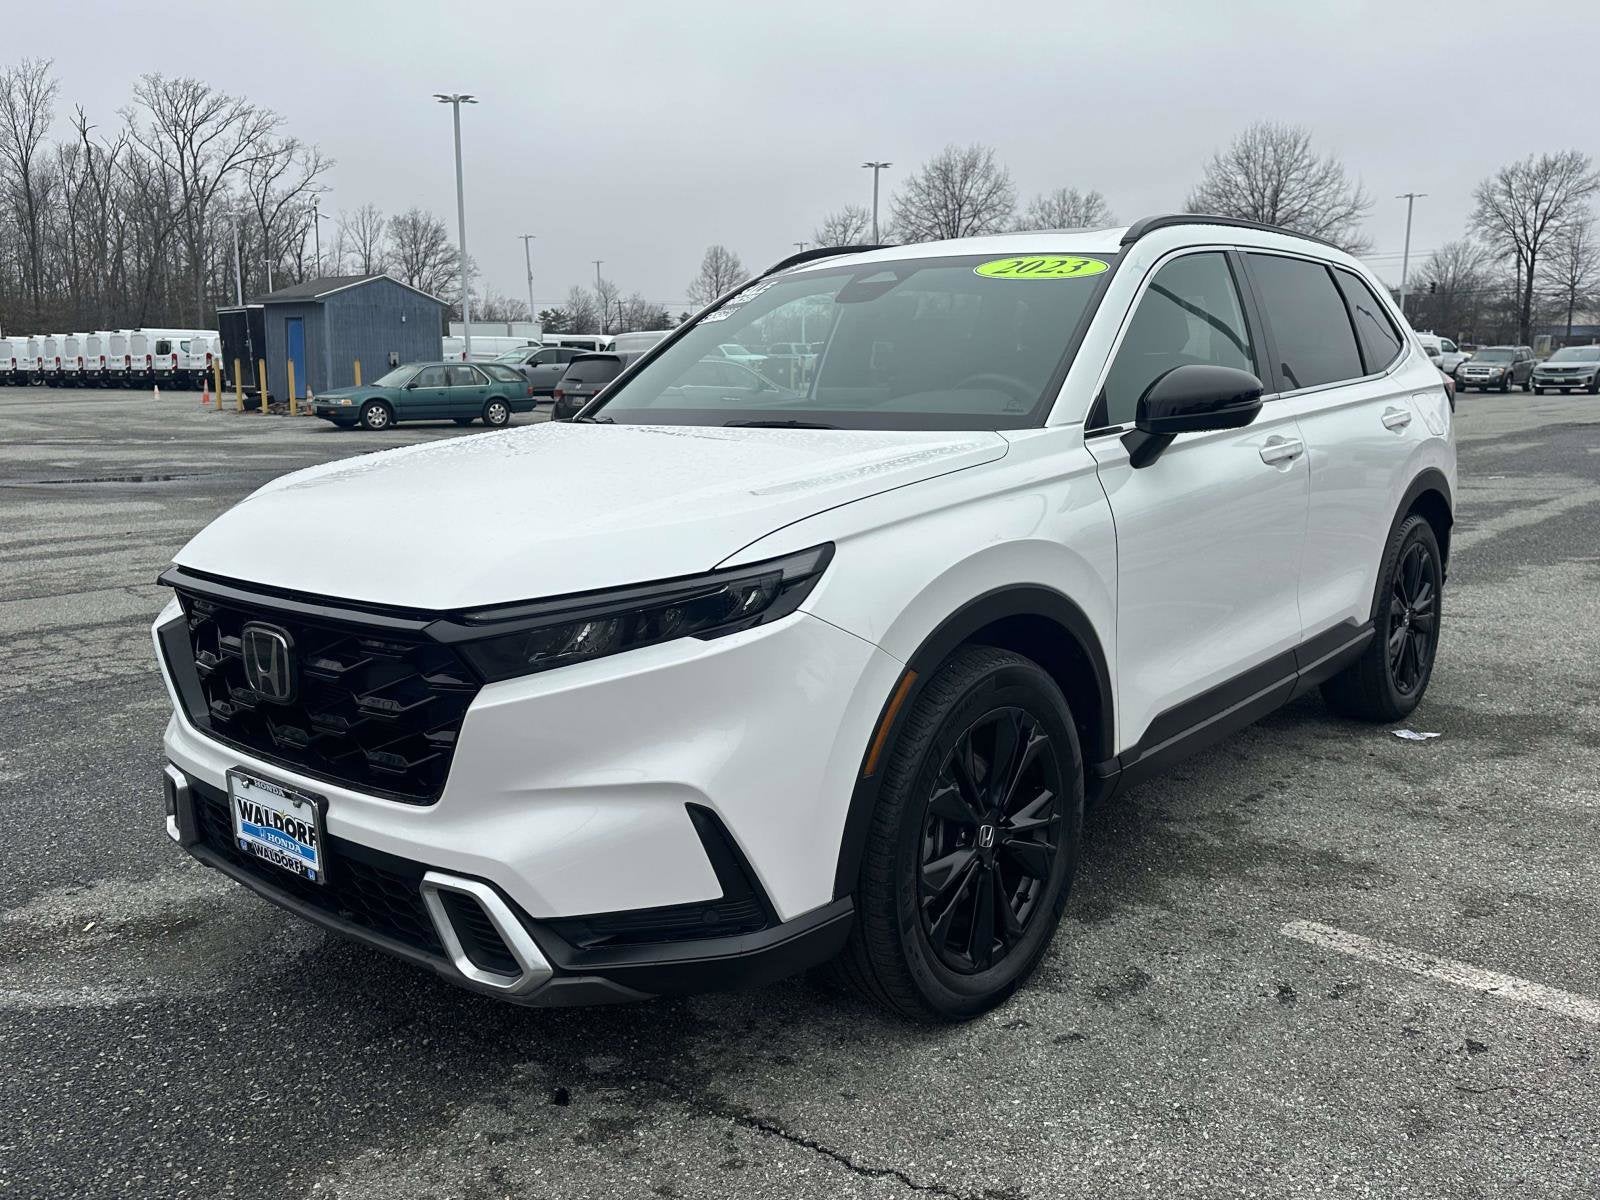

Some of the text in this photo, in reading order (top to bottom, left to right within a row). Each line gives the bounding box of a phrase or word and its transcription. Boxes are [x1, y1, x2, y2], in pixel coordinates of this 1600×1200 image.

[991, 259, 1090, 274] 2023
[253, 779, 286, 798] HONDA
[236, 797, 316, 849] WALDORF
[266, 832, 303, 854] HONDA
[252, 841, 302, 875] WALDORF
